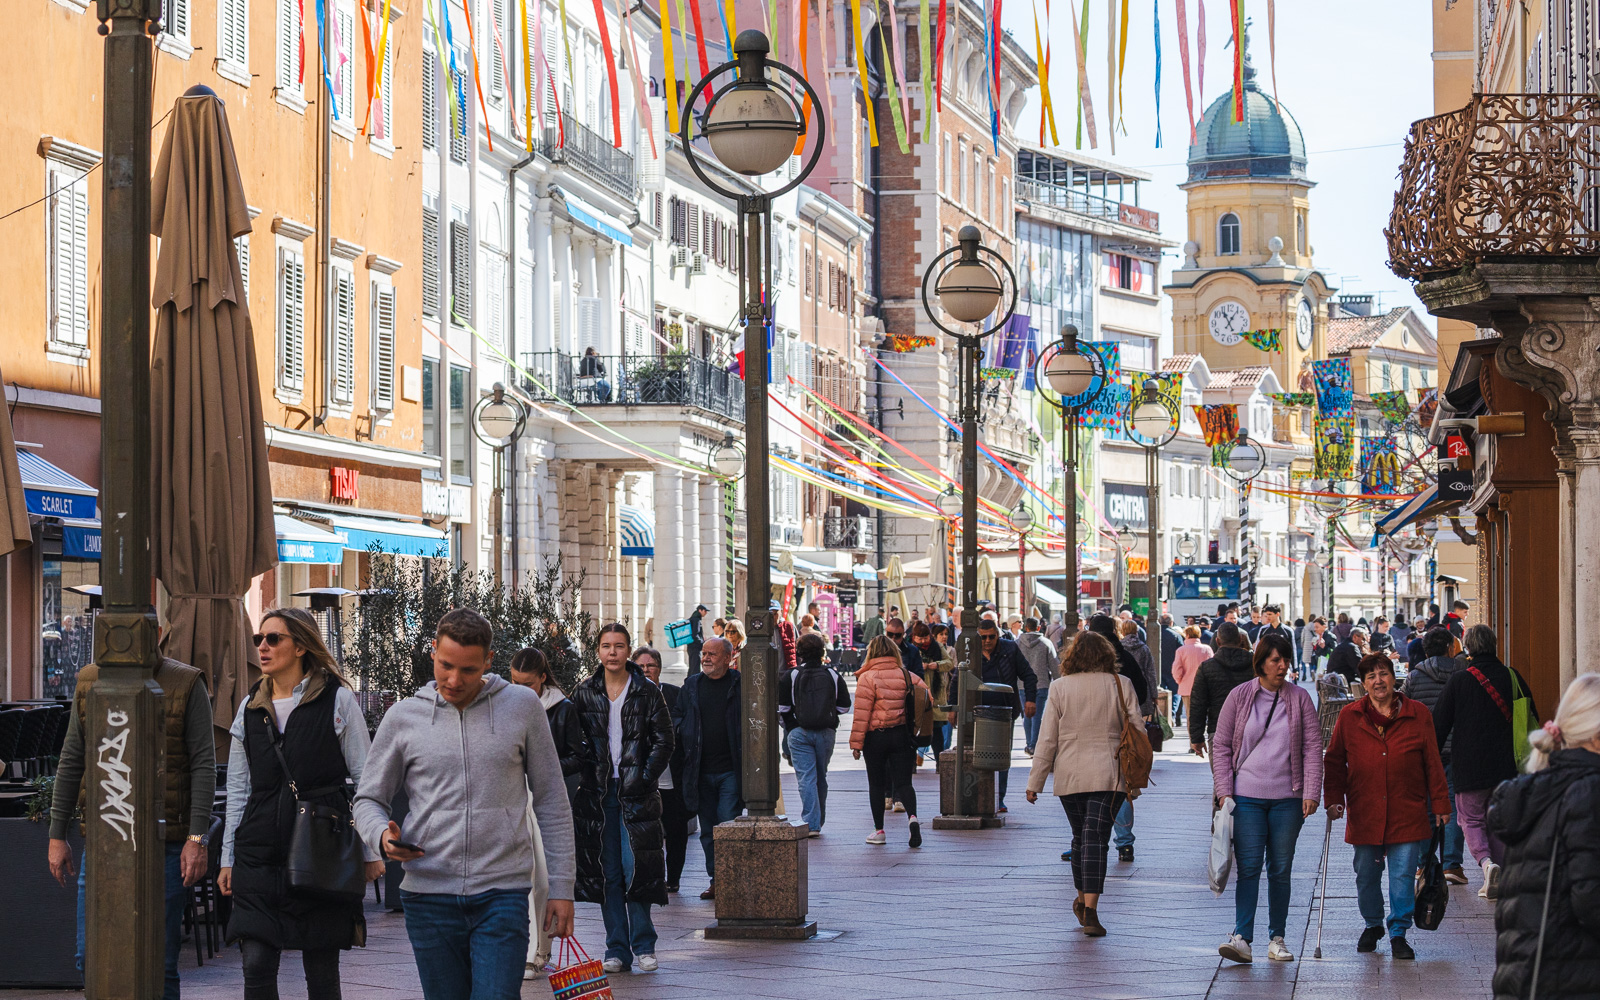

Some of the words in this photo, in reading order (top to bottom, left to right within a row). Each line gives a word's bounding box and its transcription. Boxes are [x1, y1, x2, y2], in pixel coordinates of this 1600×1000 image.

[332, 467, 359, 499] TISAK
[41, 495, 73, 514] SCARLET
[1109, 493, 1146, 521] CENTRA
